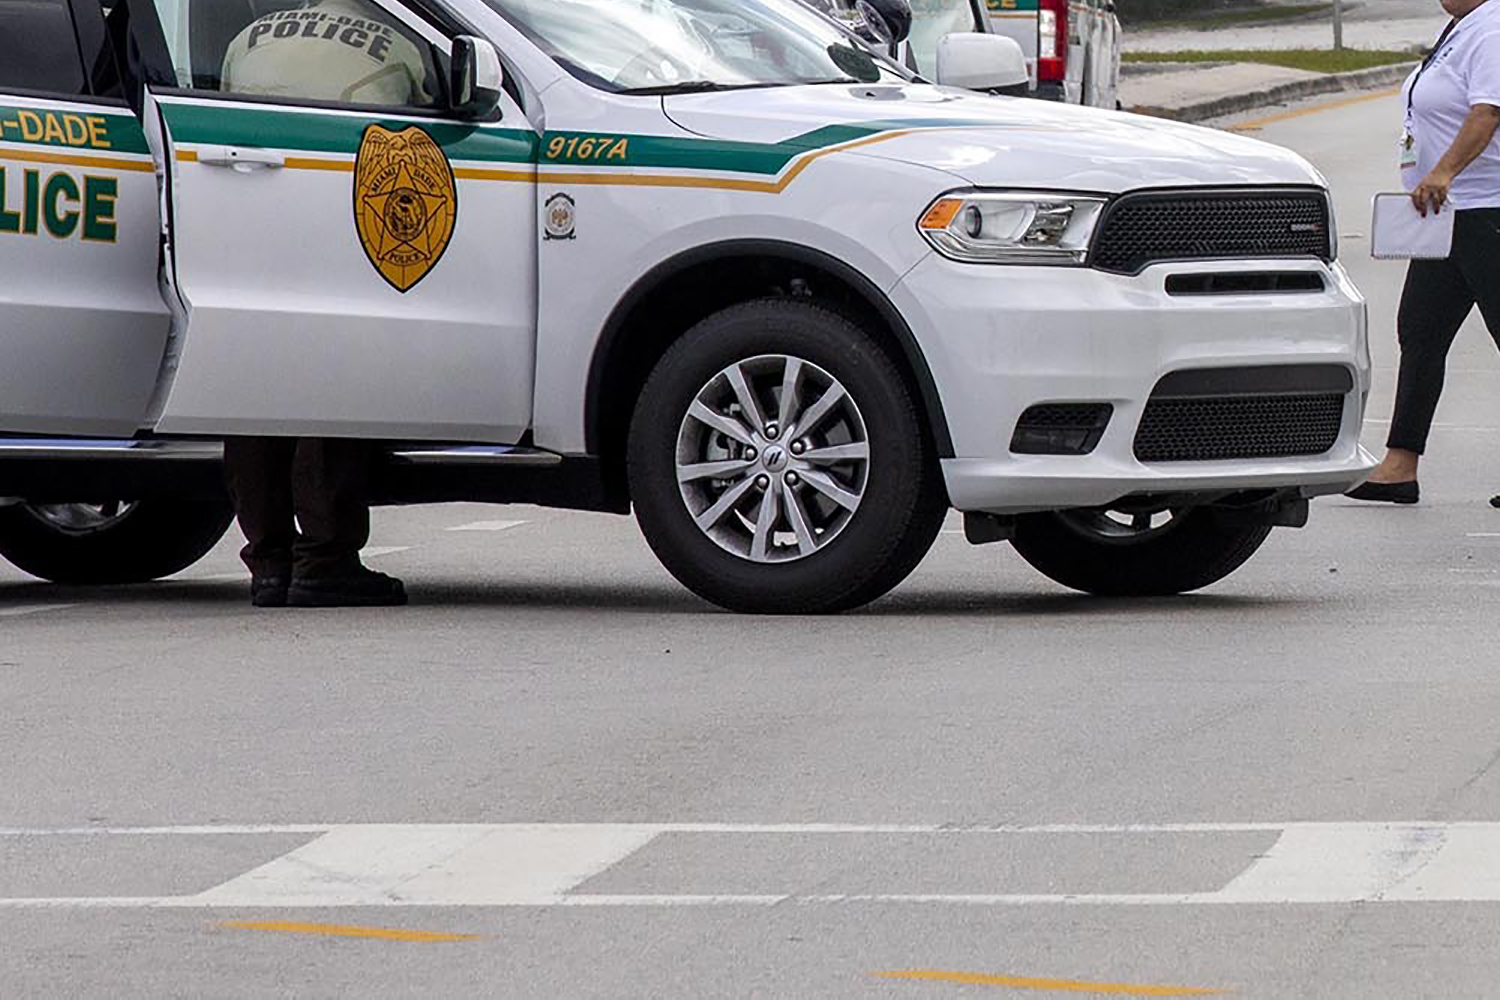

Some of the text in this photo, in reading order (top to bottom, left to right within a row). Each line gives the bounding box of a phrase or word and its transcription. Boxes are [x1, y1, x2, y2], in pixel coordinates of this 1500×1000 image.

[257, 11, 394, 38] MIAMI-DADE
[248, 20, 393, 63] POLICE
[546, 136, 628, 158] 9167A
[372, 167, 437, 192] MIAMI DADE
[388, 252, 421, 264] POLICE
